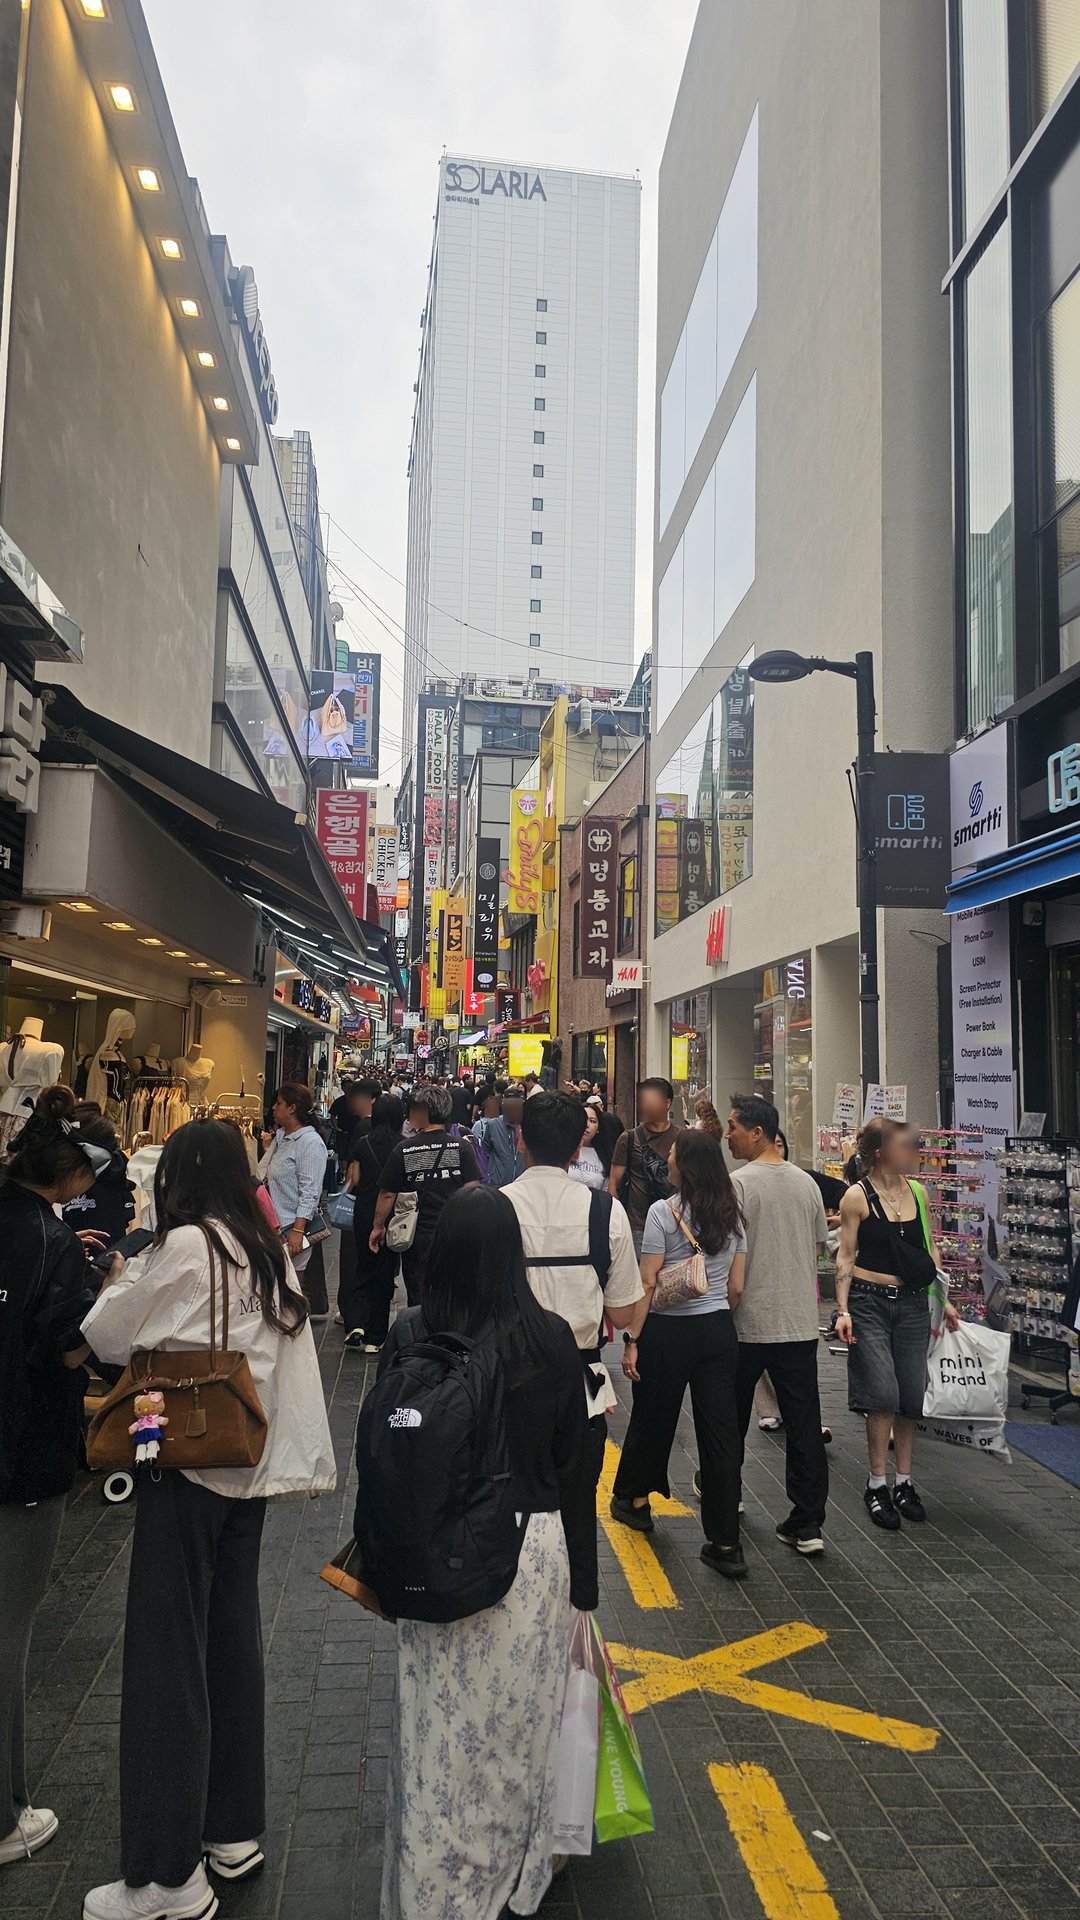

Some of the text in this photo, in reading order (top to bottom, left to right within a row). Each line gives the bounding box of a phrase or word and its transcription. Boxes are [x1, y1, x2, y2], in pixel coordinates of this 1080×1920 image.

[445, 163, 547, 202] SOLARIA
[434, 711, 443, 747] HALAL
[434, 753, 442, 784] FOOD
[324, 794, 362, 857] 은행골
[953, 805, 1002, 848] smartti
[377, 837, 386, 881] CHICKEN
[387, 838, 395, 868] OLIVE
[429, 860, 437, 885] 한우방
[588, 859, 611, 968] 명동교자
[957, 910, 973, 921] Mobile
[449, 916, 462, 951] レモン
[964, 930, 994, 944] Phone Case
[972, 956, 986, 967] USIM
[618, 967, 638, 984] H&M
[959, 979, 1002, 994] Screen Protector
[958, 993, 1002, 1009] (Free Installation)
[966, 1020, 996, 1033] Power Bank
[961, 1047, 1003, 1059] Charger & Cable
[954, 1073, 978, 1085] Earphones
[982, 1073, 1012, 1085] Headphones
[967, 1098, 998, 1111] Watch Strap
[982, 1125, 1009, 1137] Accessory
[940, 1352, 983, 1370] mini
[941, 1371, 986, 1386] brand
[934, 1428, 972, 1444] WAVES
[979, 1437, 993, 1447] OF
[609, 1759, 628, 1813] YOUNG
